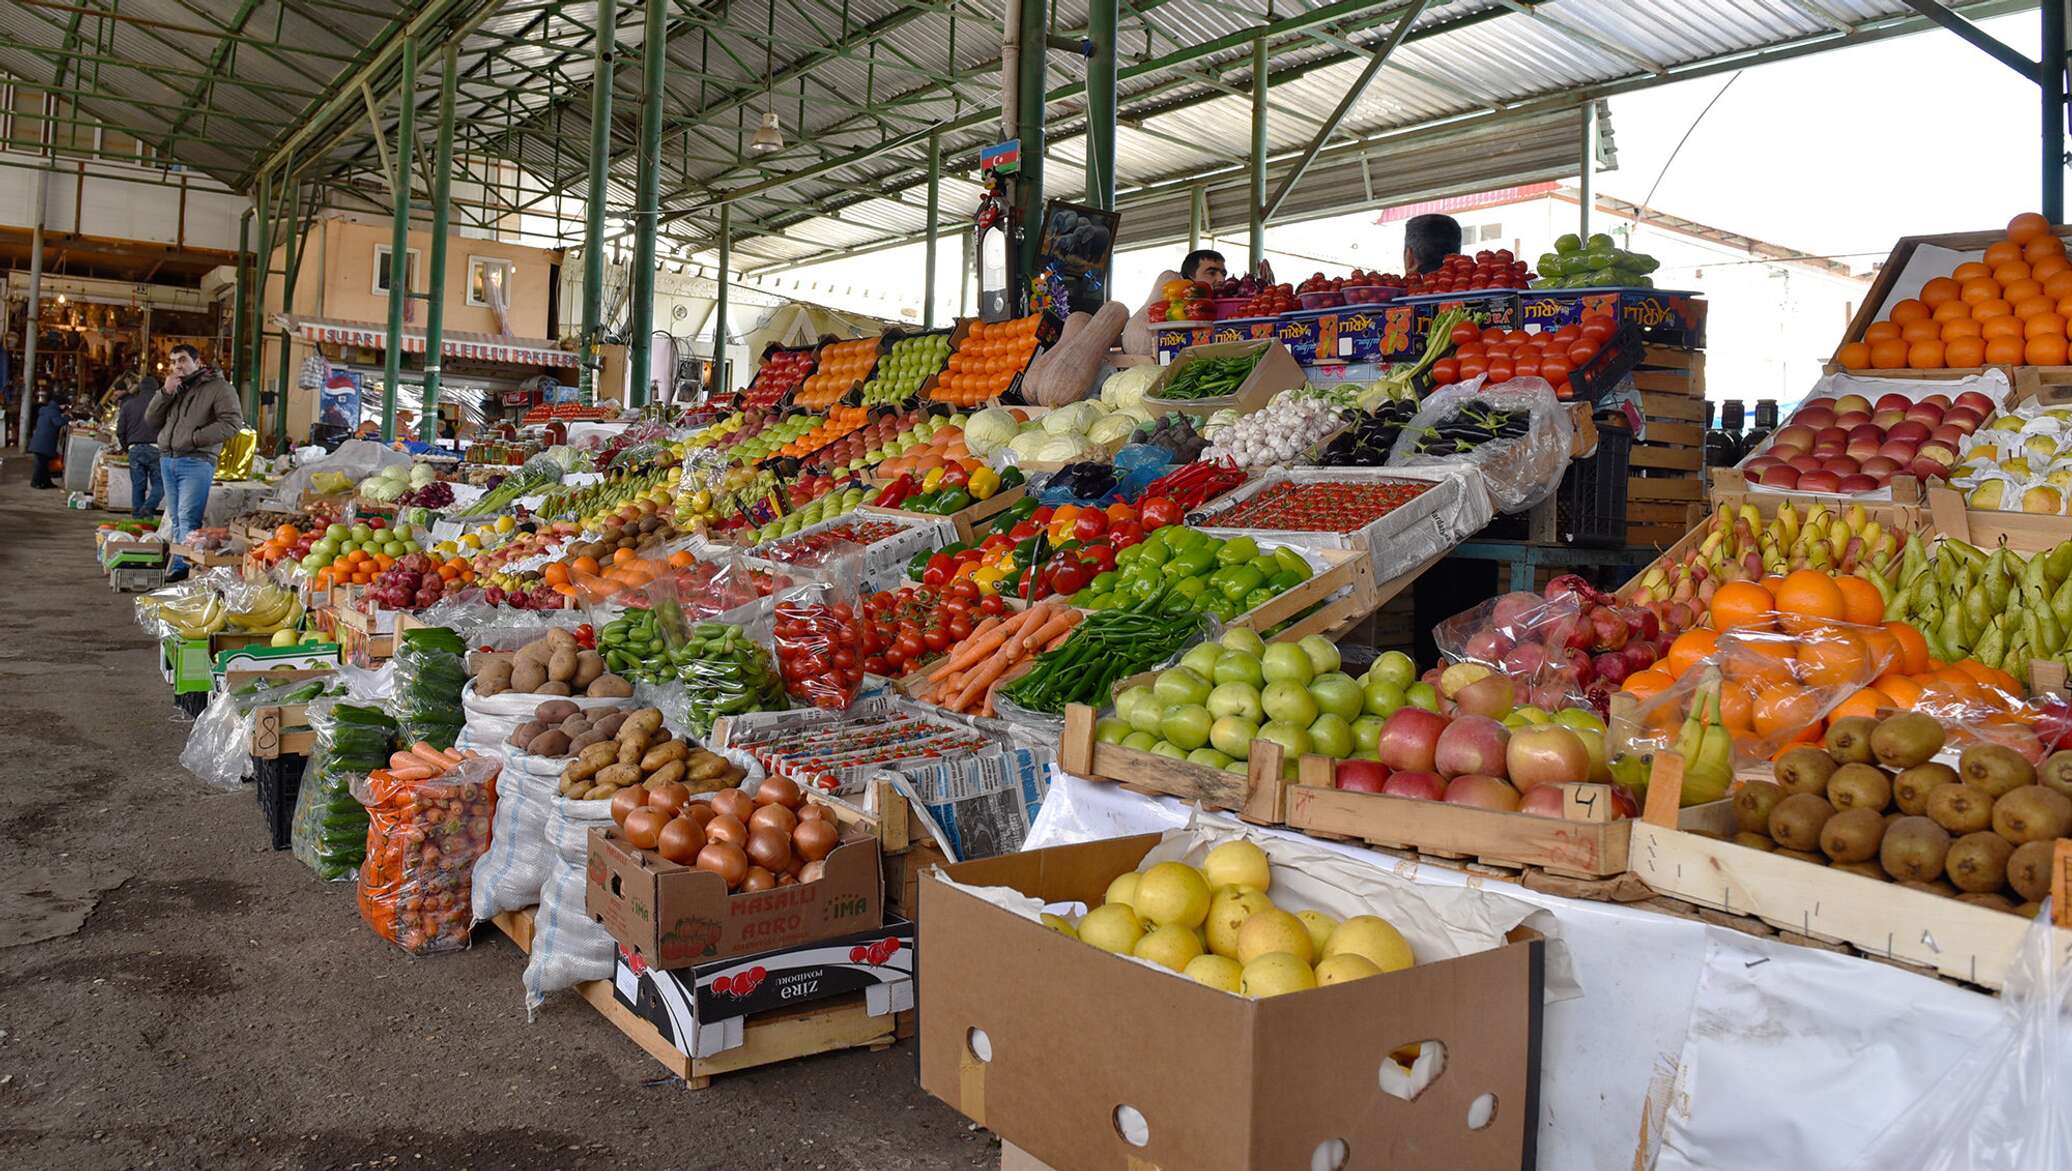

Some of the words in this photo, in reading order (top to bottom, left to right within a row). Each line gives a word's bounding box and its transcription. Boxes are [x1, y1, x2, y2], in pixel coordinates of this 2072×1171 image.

[327, 329, 373, 344] SULAR
[258, 716, 278, 750] 8
[1575, 784, 1597, 818] 4
